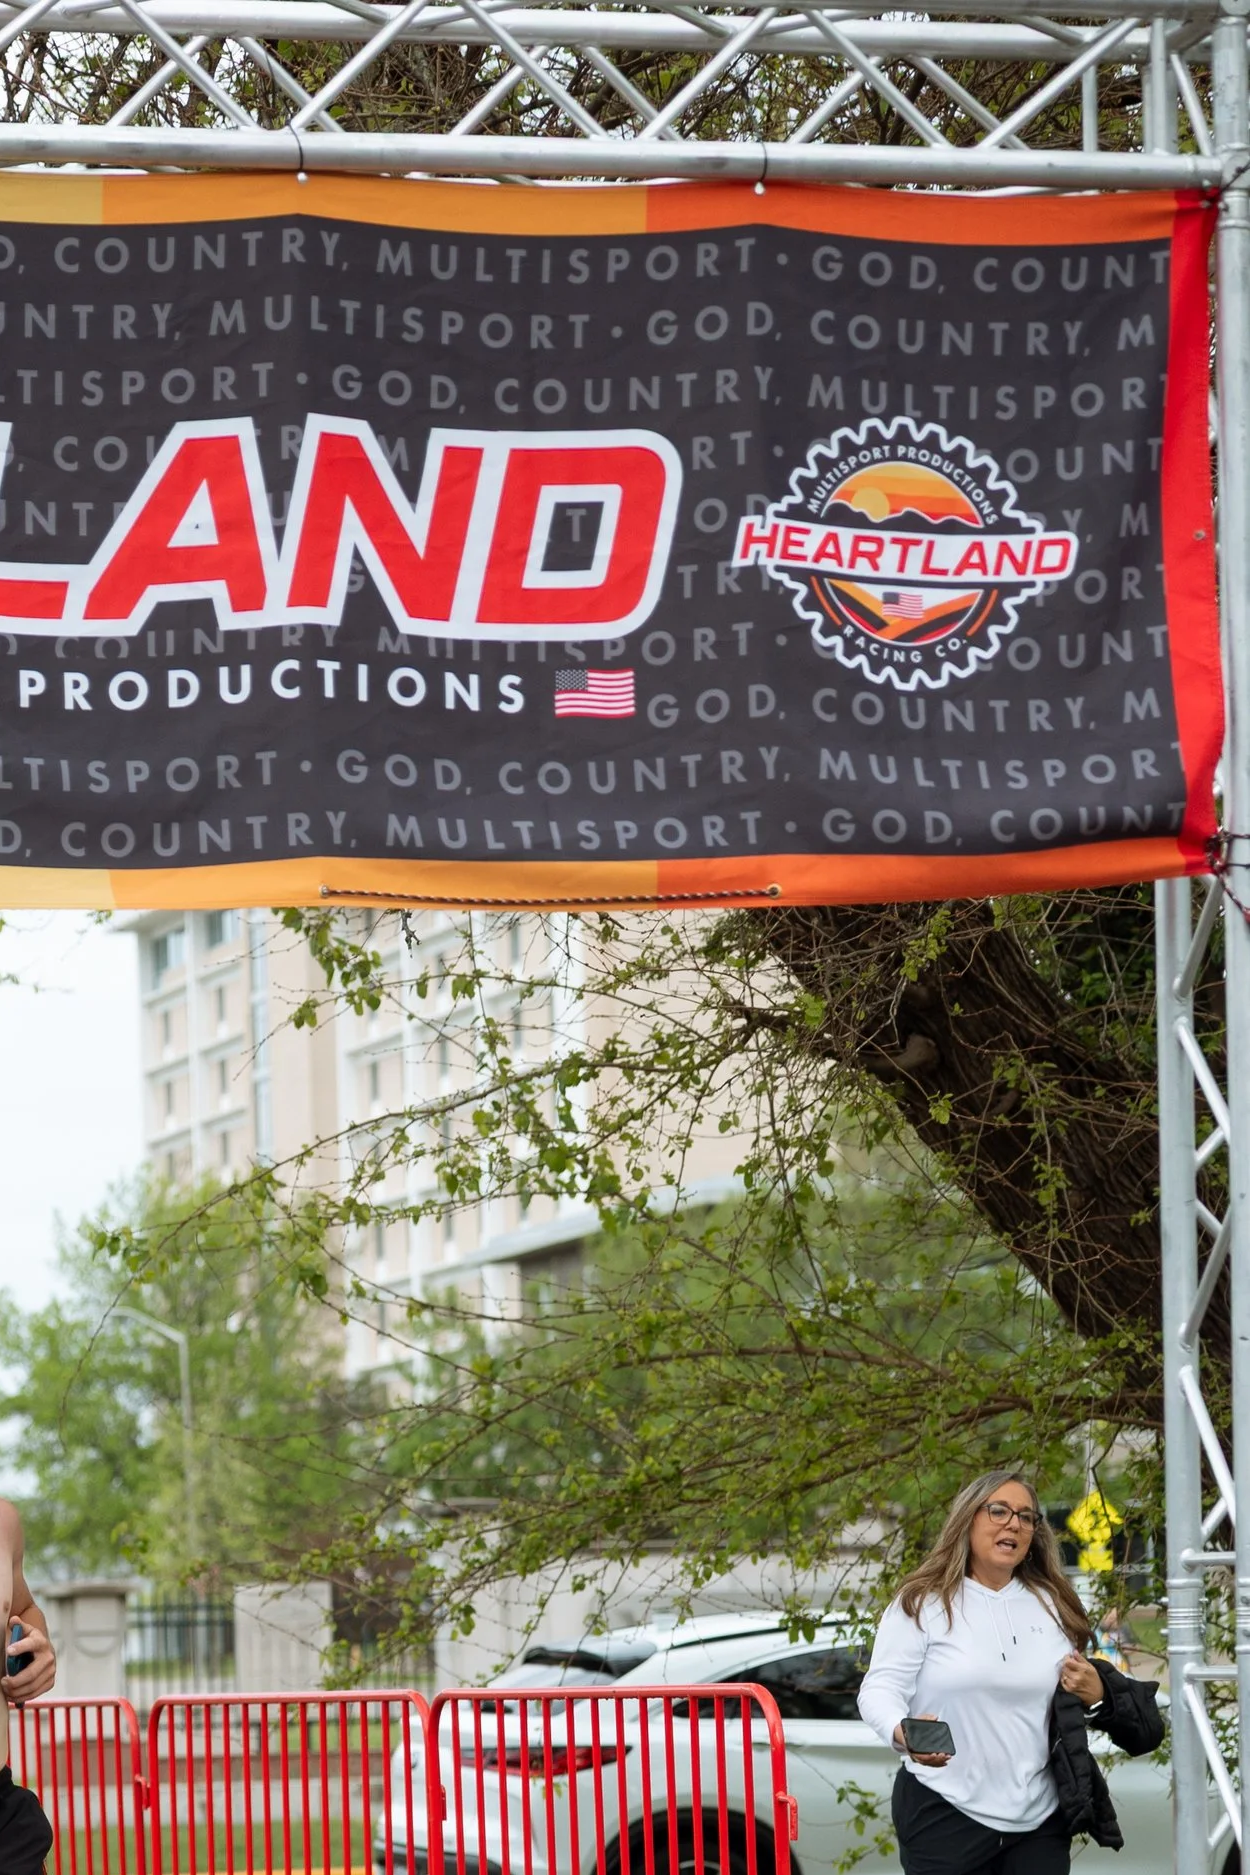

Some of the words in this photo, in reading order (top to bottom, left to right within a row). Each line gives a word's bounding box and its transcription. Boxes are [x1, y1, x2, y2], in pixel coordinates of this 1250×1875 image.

[54, 227, 348, 274] COUNTRY,
[376, 237, 756, 284] MULTISPORT
[812, 245, 945, 294] GOD,
[208, 294, 590, 349] MULTISPORT
[646, 301, 782, 346] GOD,
[810, 309, 1090, 356] COUNTRY,
[332, 364, 466, 414] GOD,
[494, 365, 781, 415] COUNTRY,
[807, 445, 891, 514] MULTISPORT
[897, 444, 999, 526] PRODUCTIONS
[976, 437, 1160, 483] OUNT
[740, 522, 1072, 577] HEARTLAND
[843, 624, 923, 663] RACING
[977, 624, 1165, 673] OUNT
[19, 659, 524, 714] PRODUCTIONS
[647, 683, 786, 728] GOD,
[812, 688, 1096, 732] COUNTRY,
[336, 749, 472, 795] GOD,
[498, 746, 790, 796] COUNTRY,
[61, 811, 356, 858] COUNTRY,
[386, 810, 762, 850] MULTISPORT
[822, 808, 962, 846] GOD,
